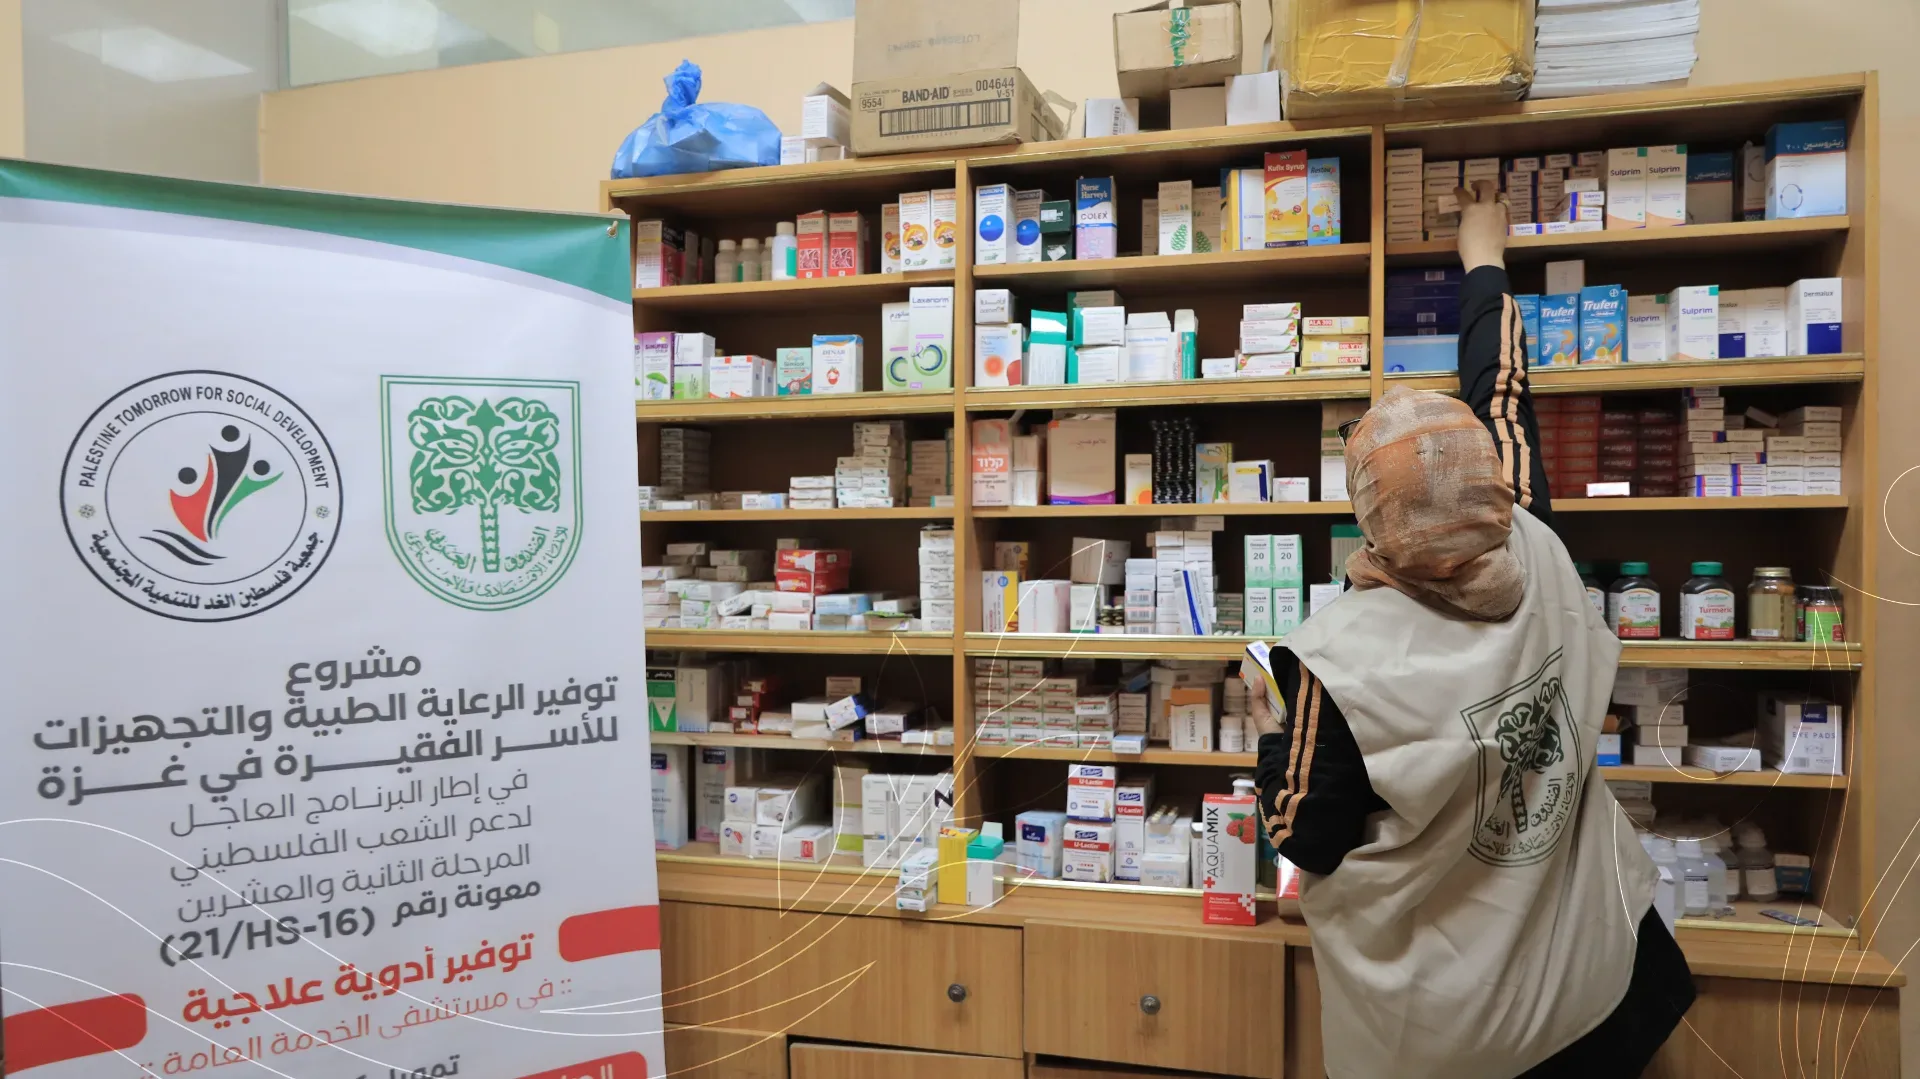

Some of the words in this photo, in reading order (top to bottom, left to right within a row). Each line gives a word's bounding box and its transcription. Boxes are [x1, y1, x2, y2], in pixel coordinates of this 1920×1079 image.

[861, 97, 882, 109] 9554
[902, 87, 950, 104] BAND-AID
[975, 77, 1015, 92] 004644
[996, 88, 1015, 98] V-51
[1285, 163, 1305, 173] Syrup
[1610, 168, 1641, 176] Sulprim
[1649, 165, 1680, 174] Sulprim
[1541, 308, 1575, 318] Trufen
[1583, 300, 1618, 311] Trufen
[1629, 315, 1660, 323] Sulprim
[78, 422, 121, 488] PALESTINE
[114, 386, 192, 427] TOMORROW
[196, 386, 223, 401] FOR
[226, 389, 272, 417] SOCIAL
[272, 410, 329, 489] DEVELOPMENT
[89, 529, 144, 588] المجتمعية
[285, 531, 324, 573] جمعية
[424, 528, 477, 574] العربي
[504, 526, 550, 572] الصندوق
[1253, 552, 1264, 560] 20
[1281, 552, 1292, 560] 20
[142, 579, 200, 610] للتنمية
[204, 594, 236, 610] الغد
[239, 569, 293, 609] فلسطين
[1253, 605, 1264, 613] 20
[1282, 605, 1293, 613] 20
[285, 645, 421, 696] مشروع
[283, 692, 406, 737] الطبية
[417, 683, 524, 726] الرعاية
[533, 676, 619, 716] توفير
[33, 704, 272, 755] والتجهيزات
[491, 712, 618, 761] للأسر
[200, 748, 262, 803] في
[274, 729, 482, 782] الفقيرة
[37, 755, 187, 806] غزة
[430, 773, 481, 807] إطار
[488, 769, 528, 805] في
[170, 793, 294, 837] العاجل
[306, 780, 422, 824] البرنامج
[356, 814, 456, 854] الشعب
[465, 805, 533, 842] لدعم
[1206, 807, 1219, 878] AQUAMIX
[170, 828, 347, 887] الفلسطيني
[342, 858, 424, 896] الثانية
[431, 842, 531, 879] المرحلة
[178, 874, 335, 923] والعشرين
[392, 889, 448, 927] رقم
[454, 880, 542, 908] معونة
[159, 906, 375, 967] (21/HS-16)
[334, 945, 434, 1001] أدوية
[443, 932, 535, 984] توفير
[183, 976, 325, 1029] علاجية
[377, 991, 508, 1040] مستشفى
[270, 1013, 370, 1055] الخدمة
[163, 1035, 262, 1076] العامة
